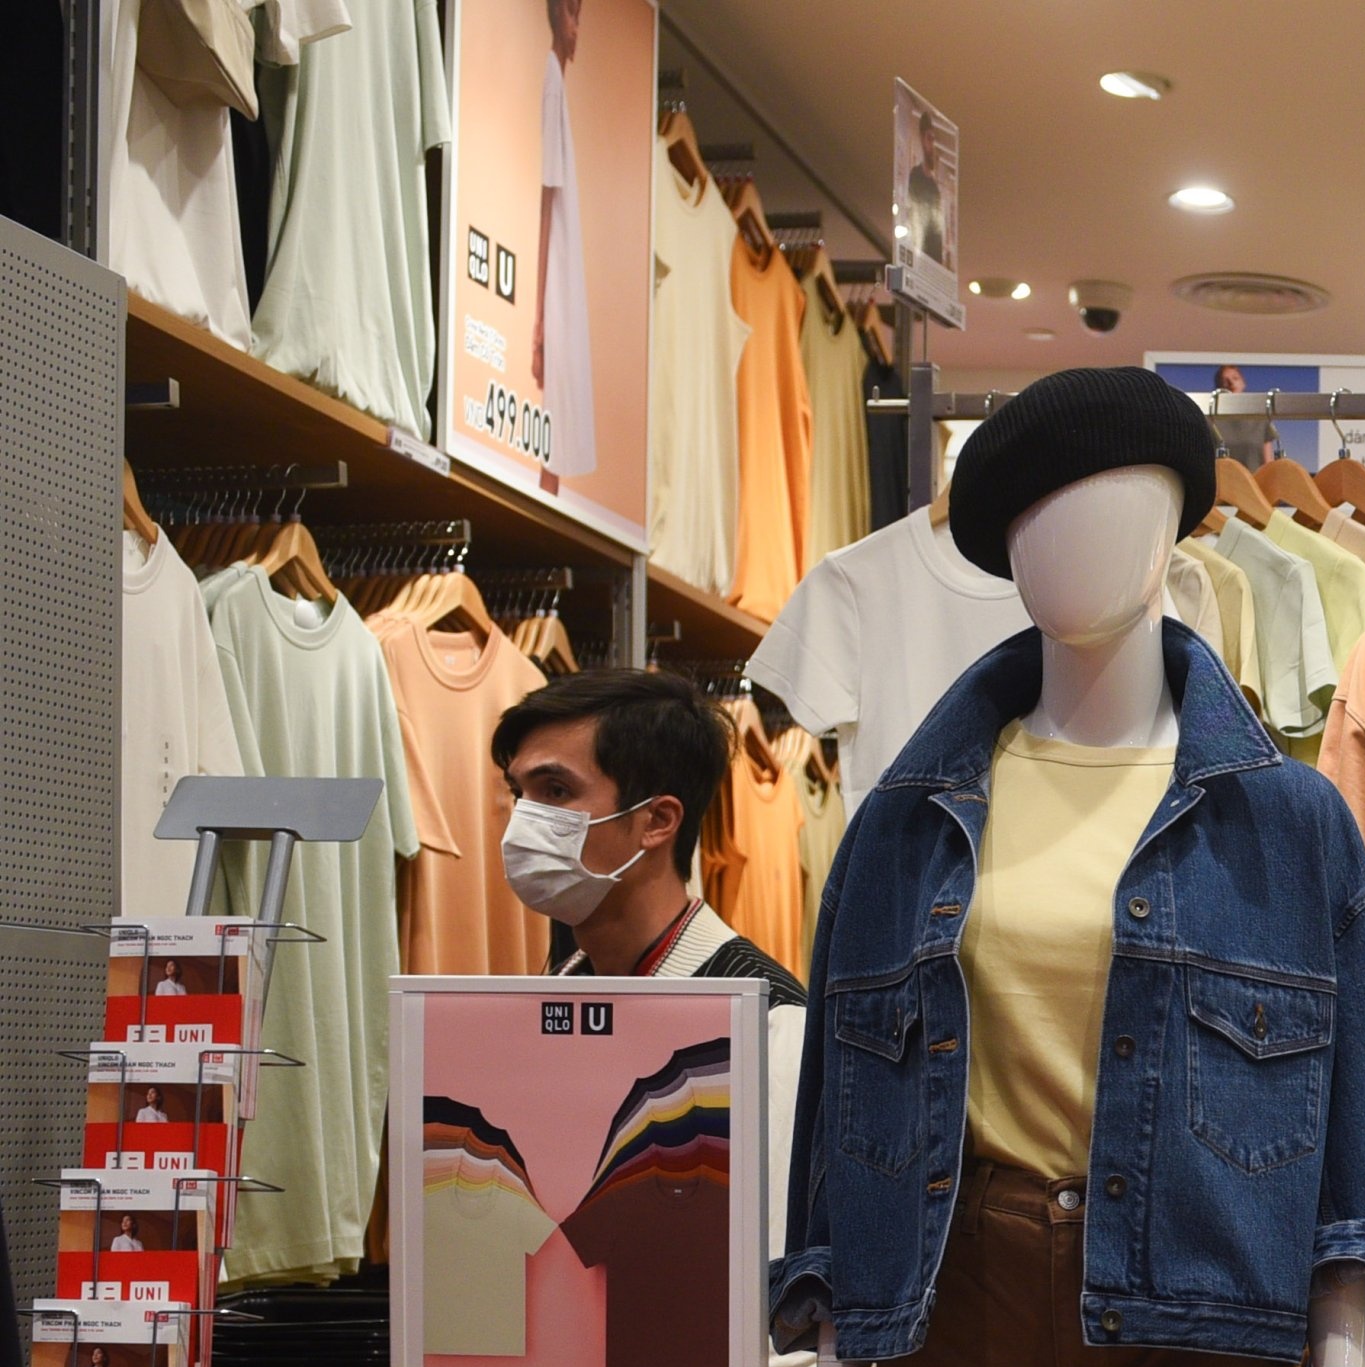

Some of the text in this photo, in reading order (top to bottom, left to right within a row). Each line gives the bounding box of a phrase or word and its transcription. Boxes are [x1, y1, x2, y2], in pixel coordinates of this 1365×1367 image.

[588, 1006, 606, 1032] U
[179, 1030, 205, 1042] UNI
[159, 1157, 187, 1170] UNI
[135, 1287, 161, 1300] UNI
